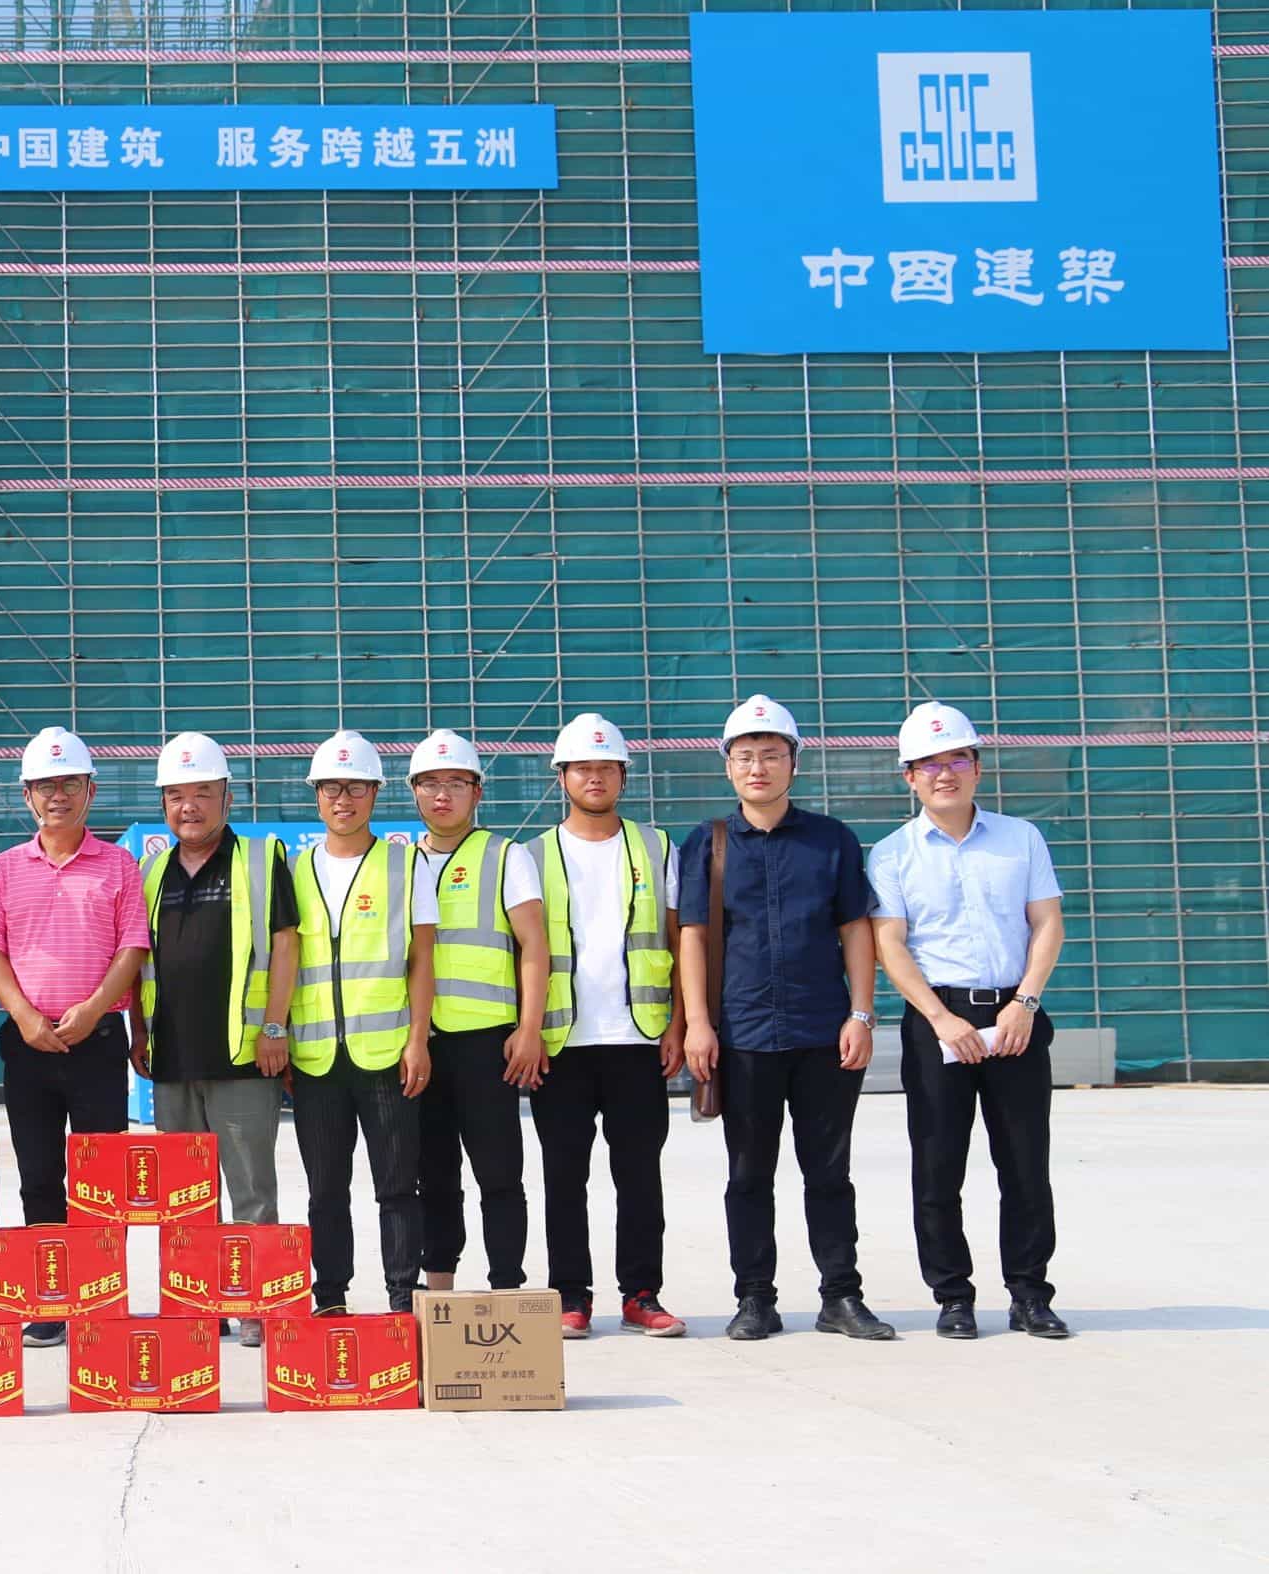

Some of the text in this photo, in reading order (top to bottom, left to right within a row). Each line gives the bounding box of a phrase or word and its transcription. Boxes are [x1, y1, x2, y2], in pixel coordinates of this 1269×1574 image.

[216, 125, 518, 170] 服务跨越五洲
[75, 1181, 116, 1207] 怕上火
[137, 1156, 148, 1196] 王老吉
[46, 1250, 58, 1290] 王老吉
[168, 1270, 209, 1297] 怕上火
[229, 1246, 241, 1286] 王老吉
[464, 1323, 522, 1346] LUX
[138, 1341, 150, 1381] 王老吉
[275, 1364, 316, 1391] 怕上火
[337, 1338, 348, 1379] 王老吉
[77, 1366, 118, 1393] 怕上火
